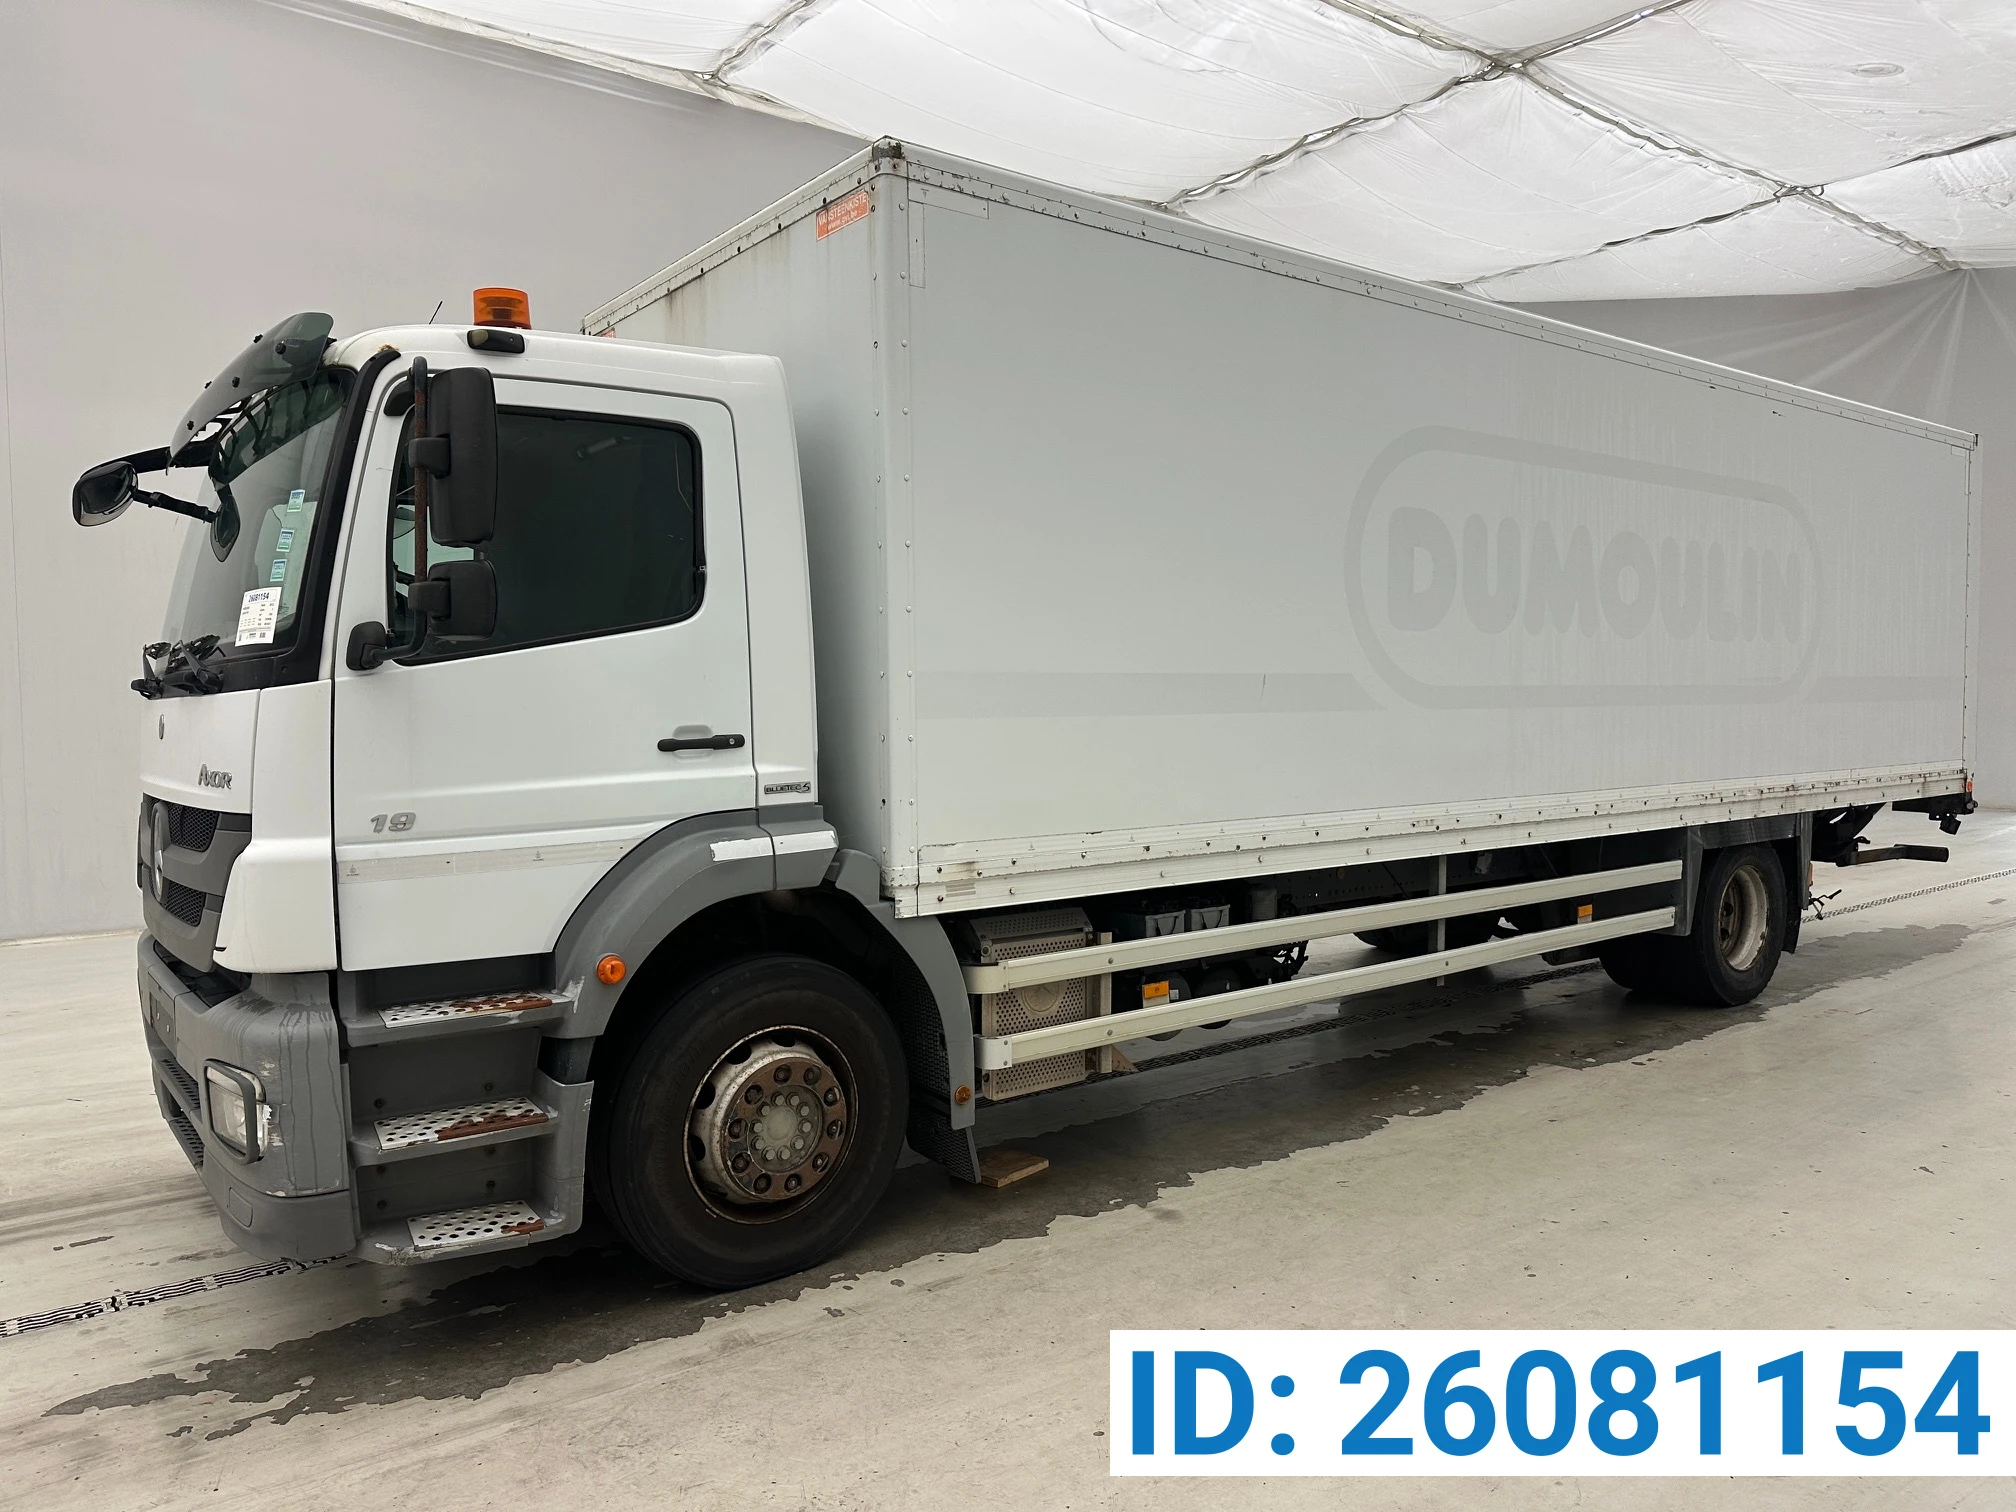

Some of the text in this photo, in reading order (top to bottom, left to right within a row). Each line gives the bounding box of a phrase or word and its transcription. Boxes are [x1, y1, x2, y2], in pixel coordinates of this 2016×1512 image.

[1387, 506, 1802, 645] DUMOULIN
[766, 784, 801, 792] BLUETEC
[370, 811, 417, 834] 19
